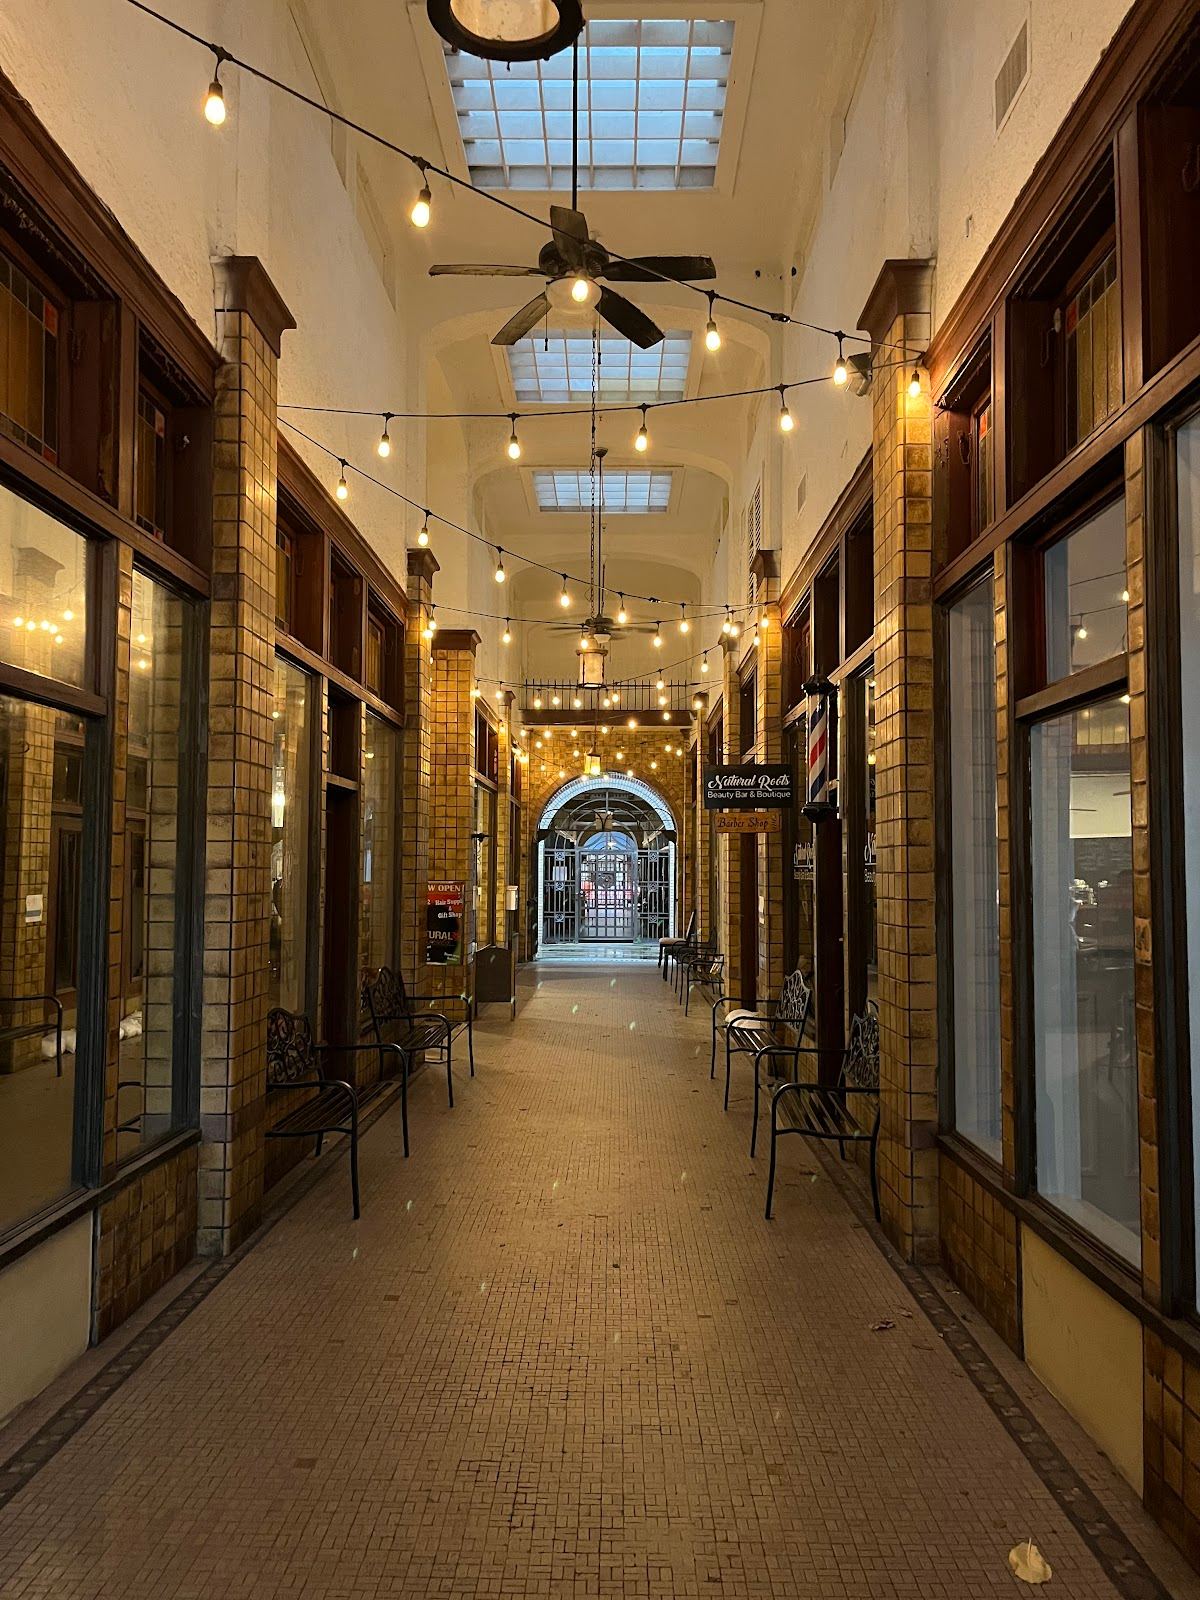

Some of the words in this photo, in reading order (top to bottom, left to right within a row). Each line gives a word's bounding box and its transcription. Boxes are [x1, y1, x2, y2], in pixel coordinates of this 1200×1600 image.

[708, 774, 756, 790] Natural
[759, 774, 790, 791] Roots
[707, 791, 734, 799] Beauty
[757, 791, 791, 799] Boutique
[719, 817, 745, 828] Barber
[748, 817, 769, 830] Shop
[427, 884, 436, 892] W
[438, 884, 461, 892] OPEN
